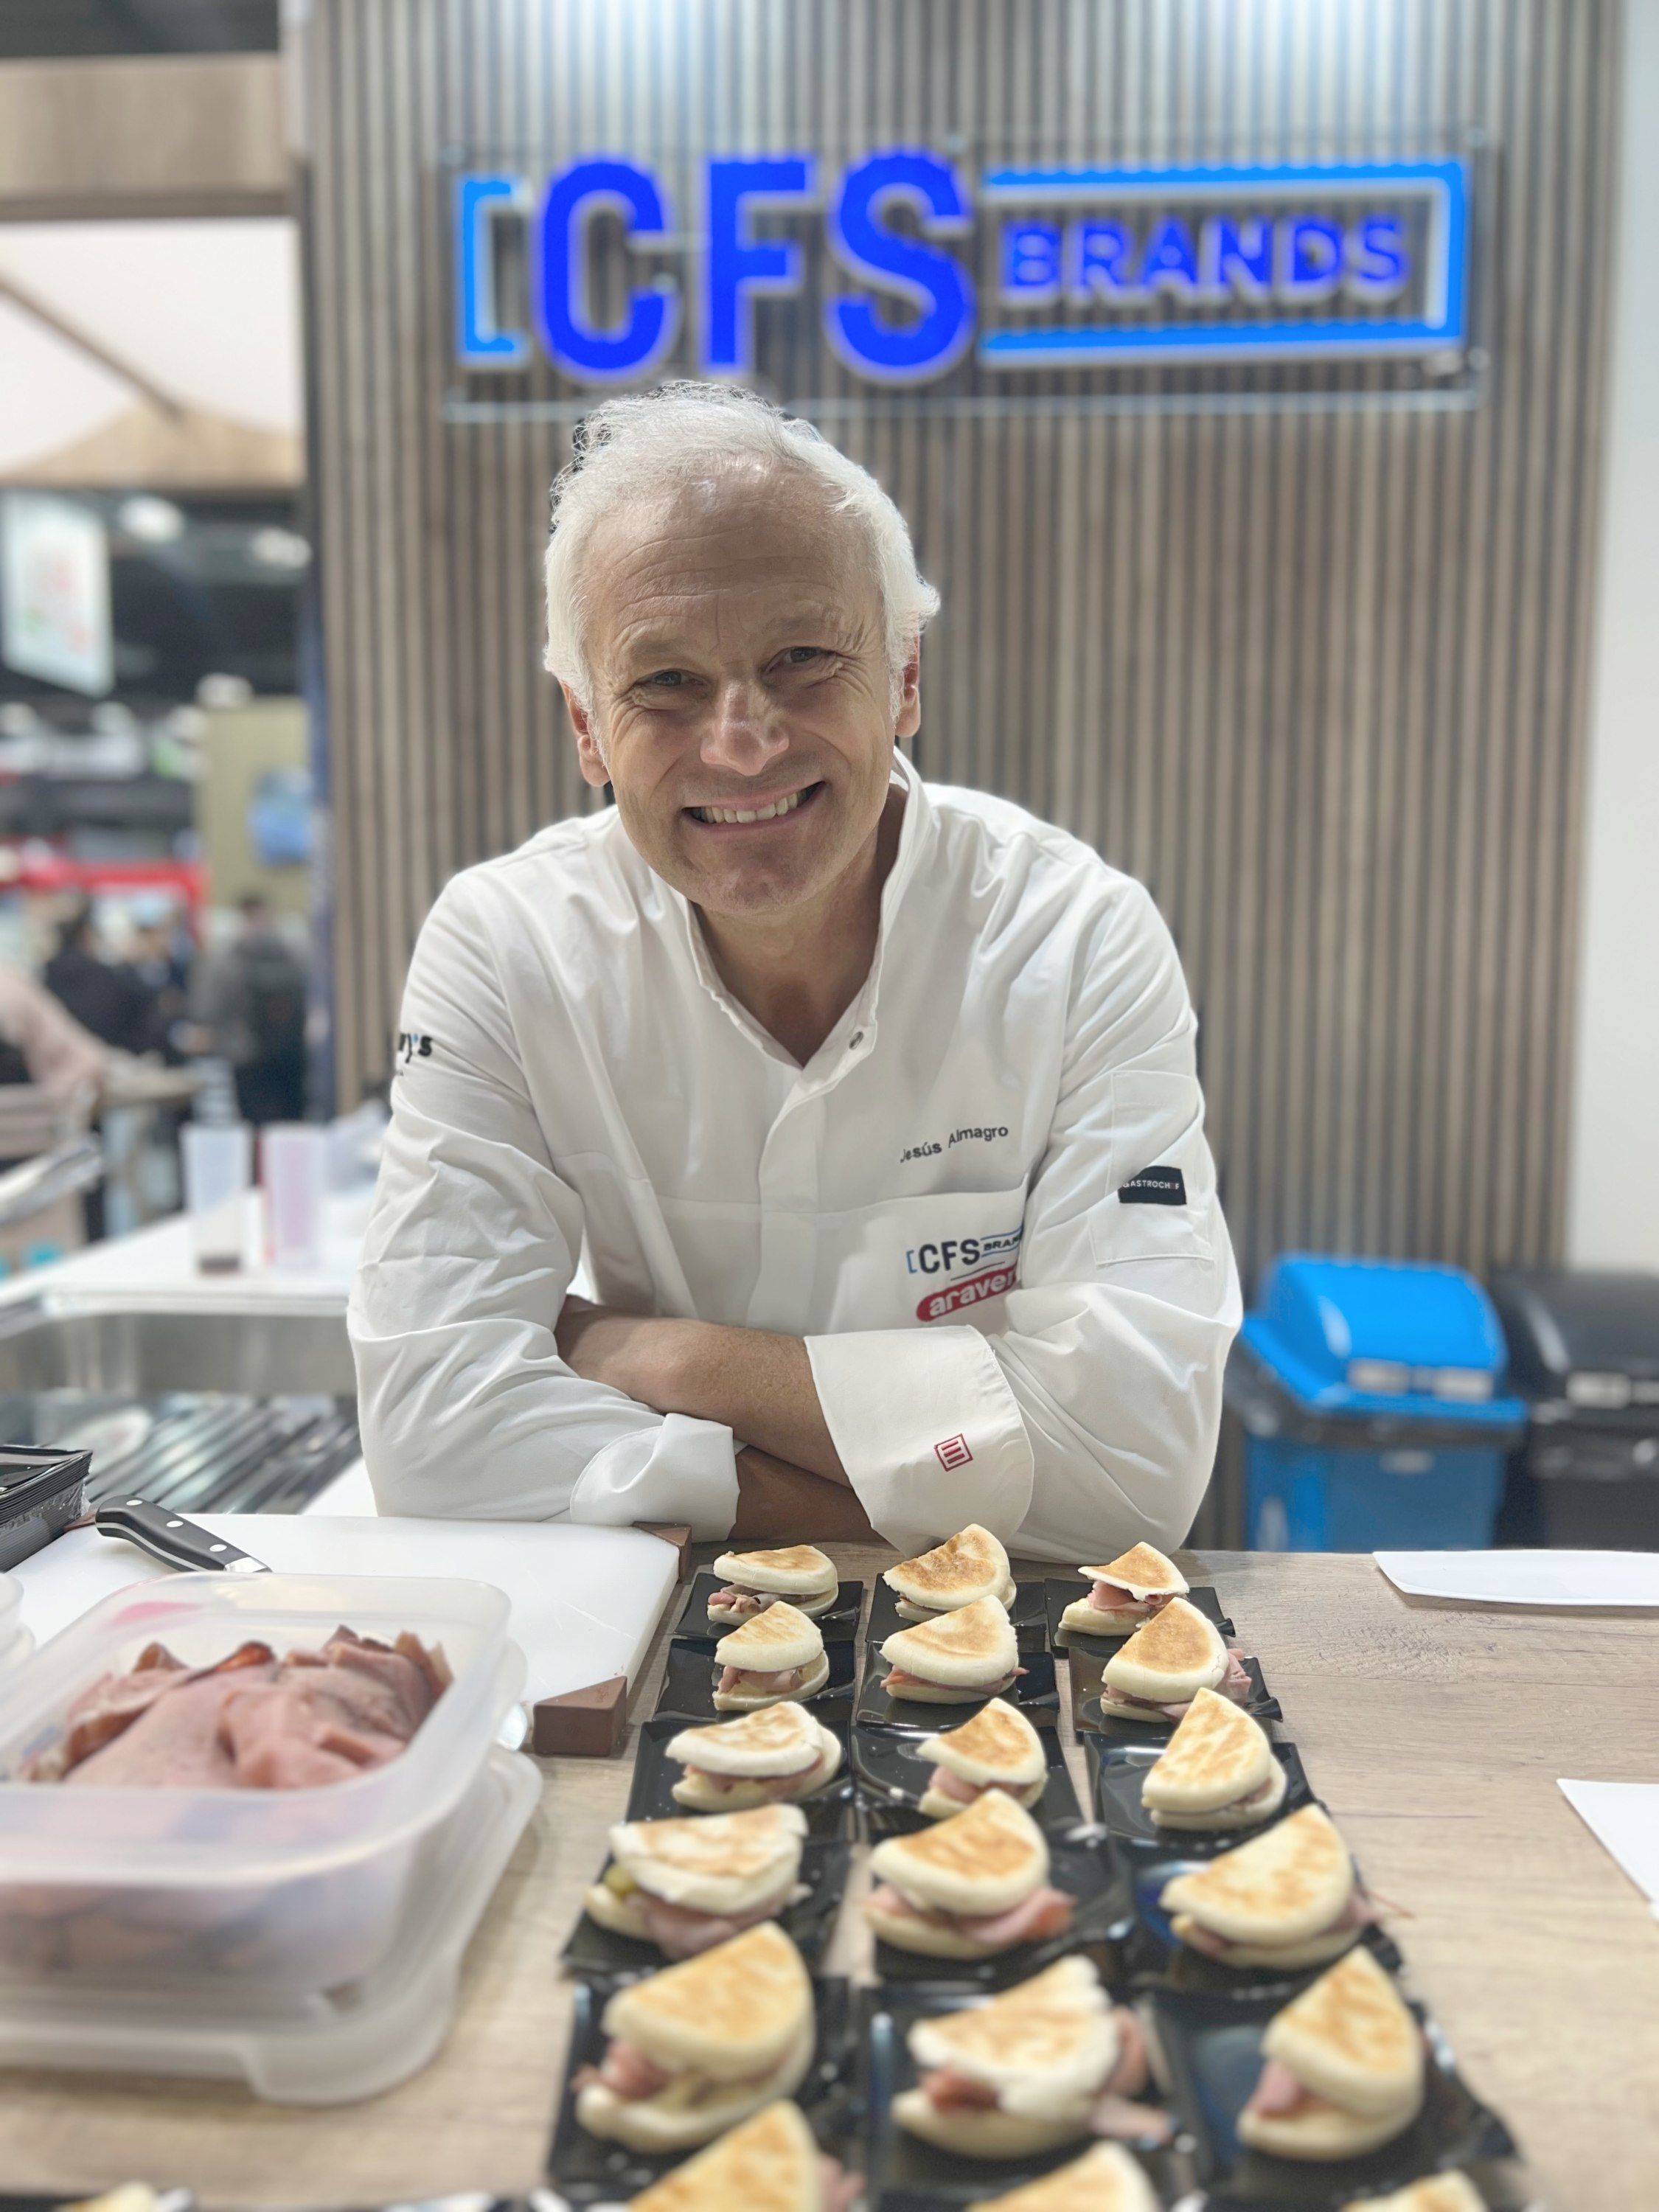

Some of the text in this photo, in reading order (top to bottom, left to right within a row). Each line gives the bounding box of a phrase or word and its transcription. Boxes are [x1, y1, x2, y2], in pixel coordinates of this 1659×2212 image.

[540, 150, 1411, 380] CFS BRANDS
[900, 1126, 1009, 1163] Jesús Almagro
[918, 1239, 981, 1274] CFS
